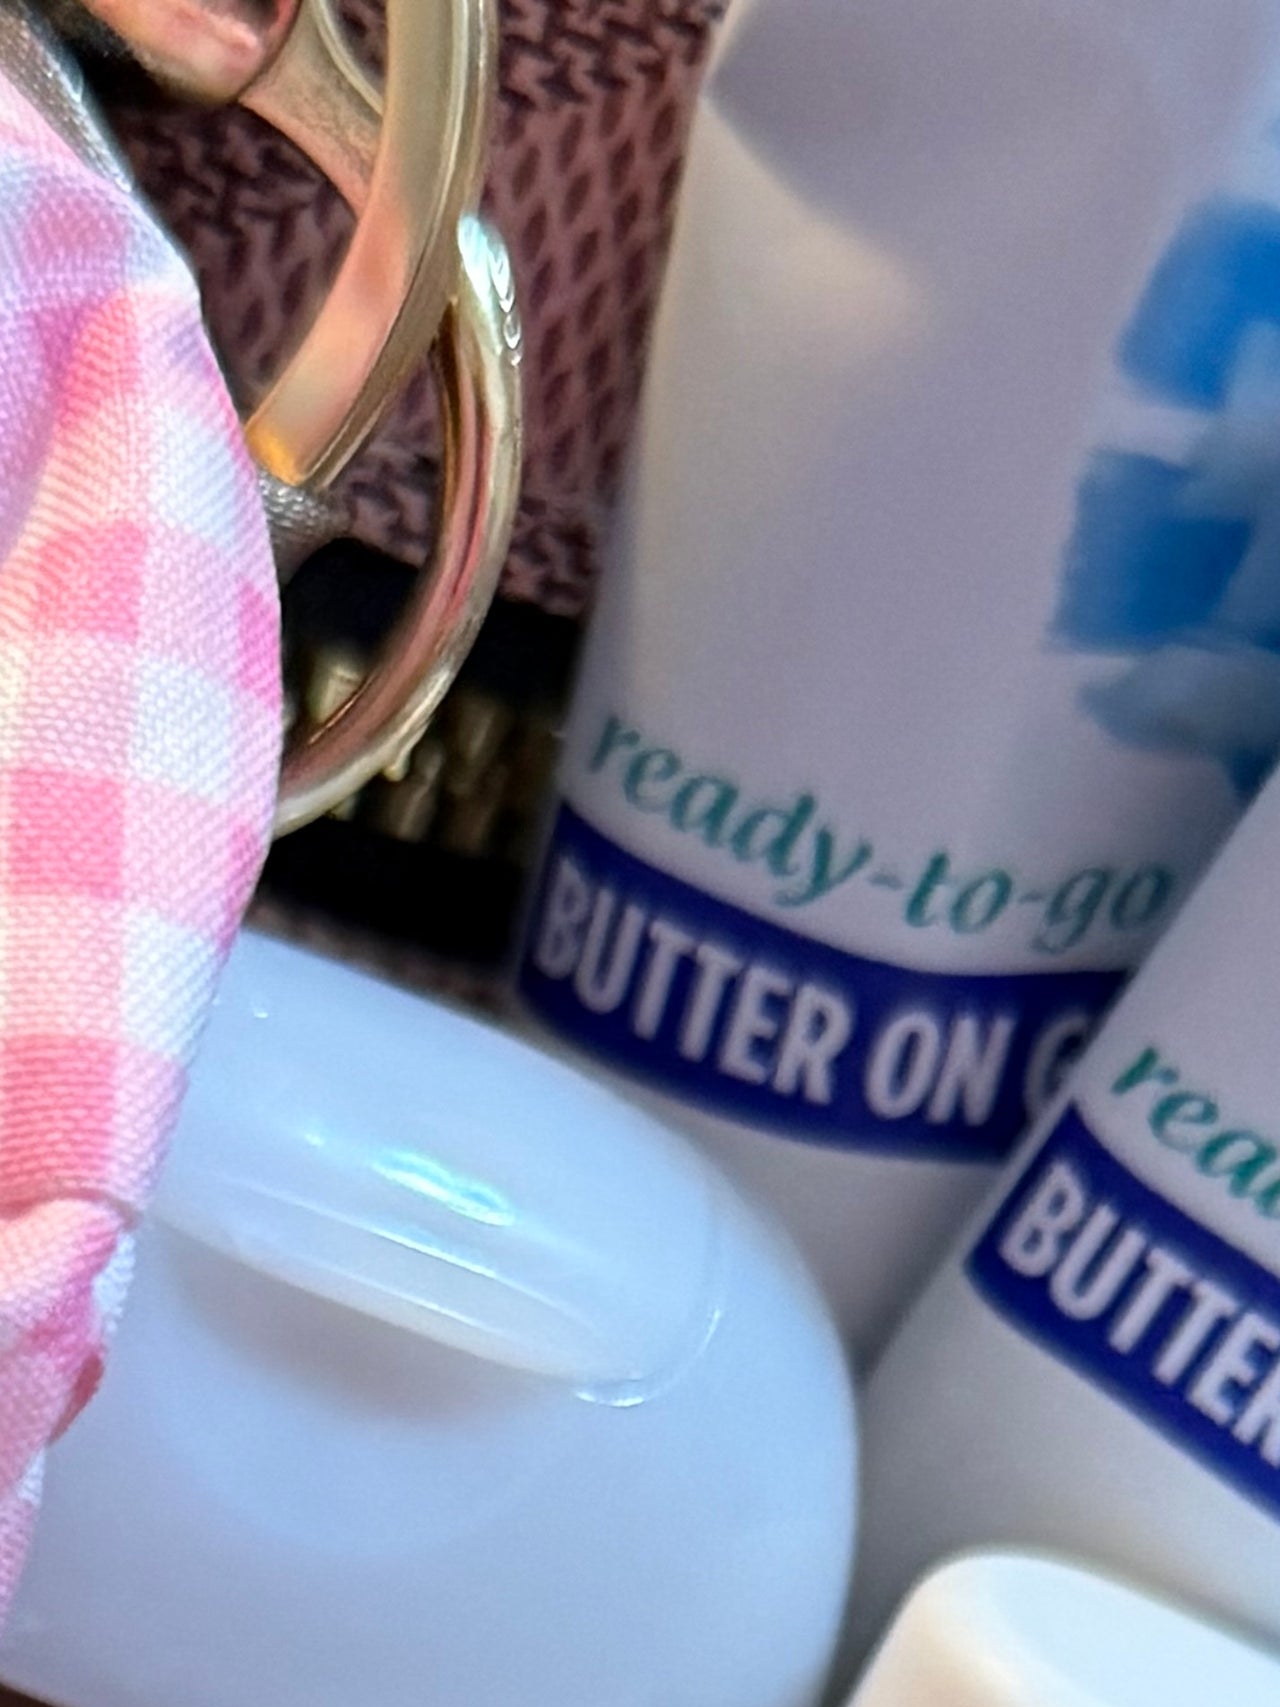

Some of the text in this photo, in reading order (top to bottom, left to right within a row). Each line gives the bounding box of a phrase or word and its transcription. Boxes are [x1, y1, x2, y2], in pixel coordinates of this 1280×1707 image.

[586, 714, 1176, 956] ready-to-go
[532, 855, 854, 1104] BUTTER
[864, 1008, 1016, 1127] ON
